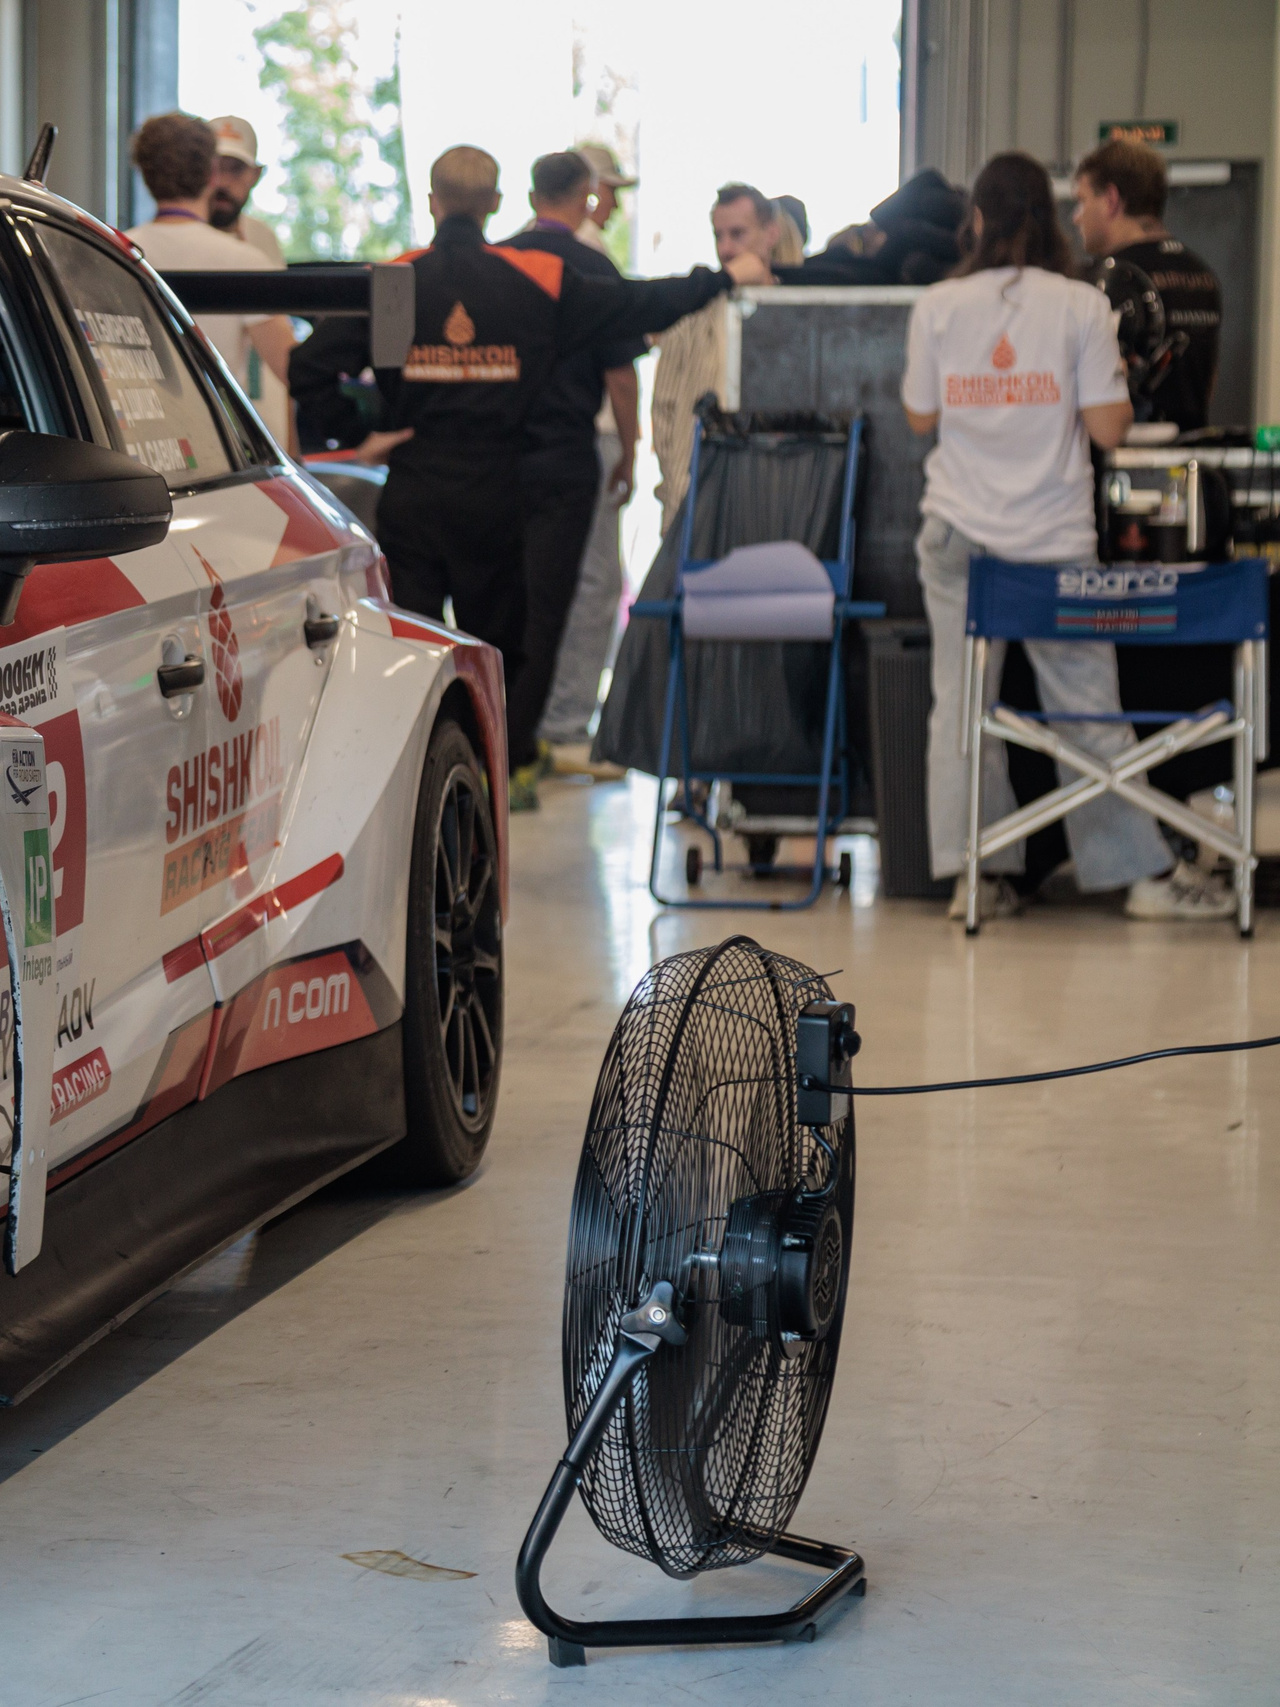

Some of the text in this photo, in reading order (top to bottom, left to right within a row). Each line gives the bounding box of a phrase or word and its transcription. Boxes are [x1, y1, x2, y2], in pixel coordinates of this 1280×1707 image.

[1057, 566, 1179, 600] sparco
[166, 716, 284, 845] SHISHKOIL
[29, 855, 48, 924] IP
[23, 954, 52, 985] integra
[53, 1058, 106, 1112] RACING
